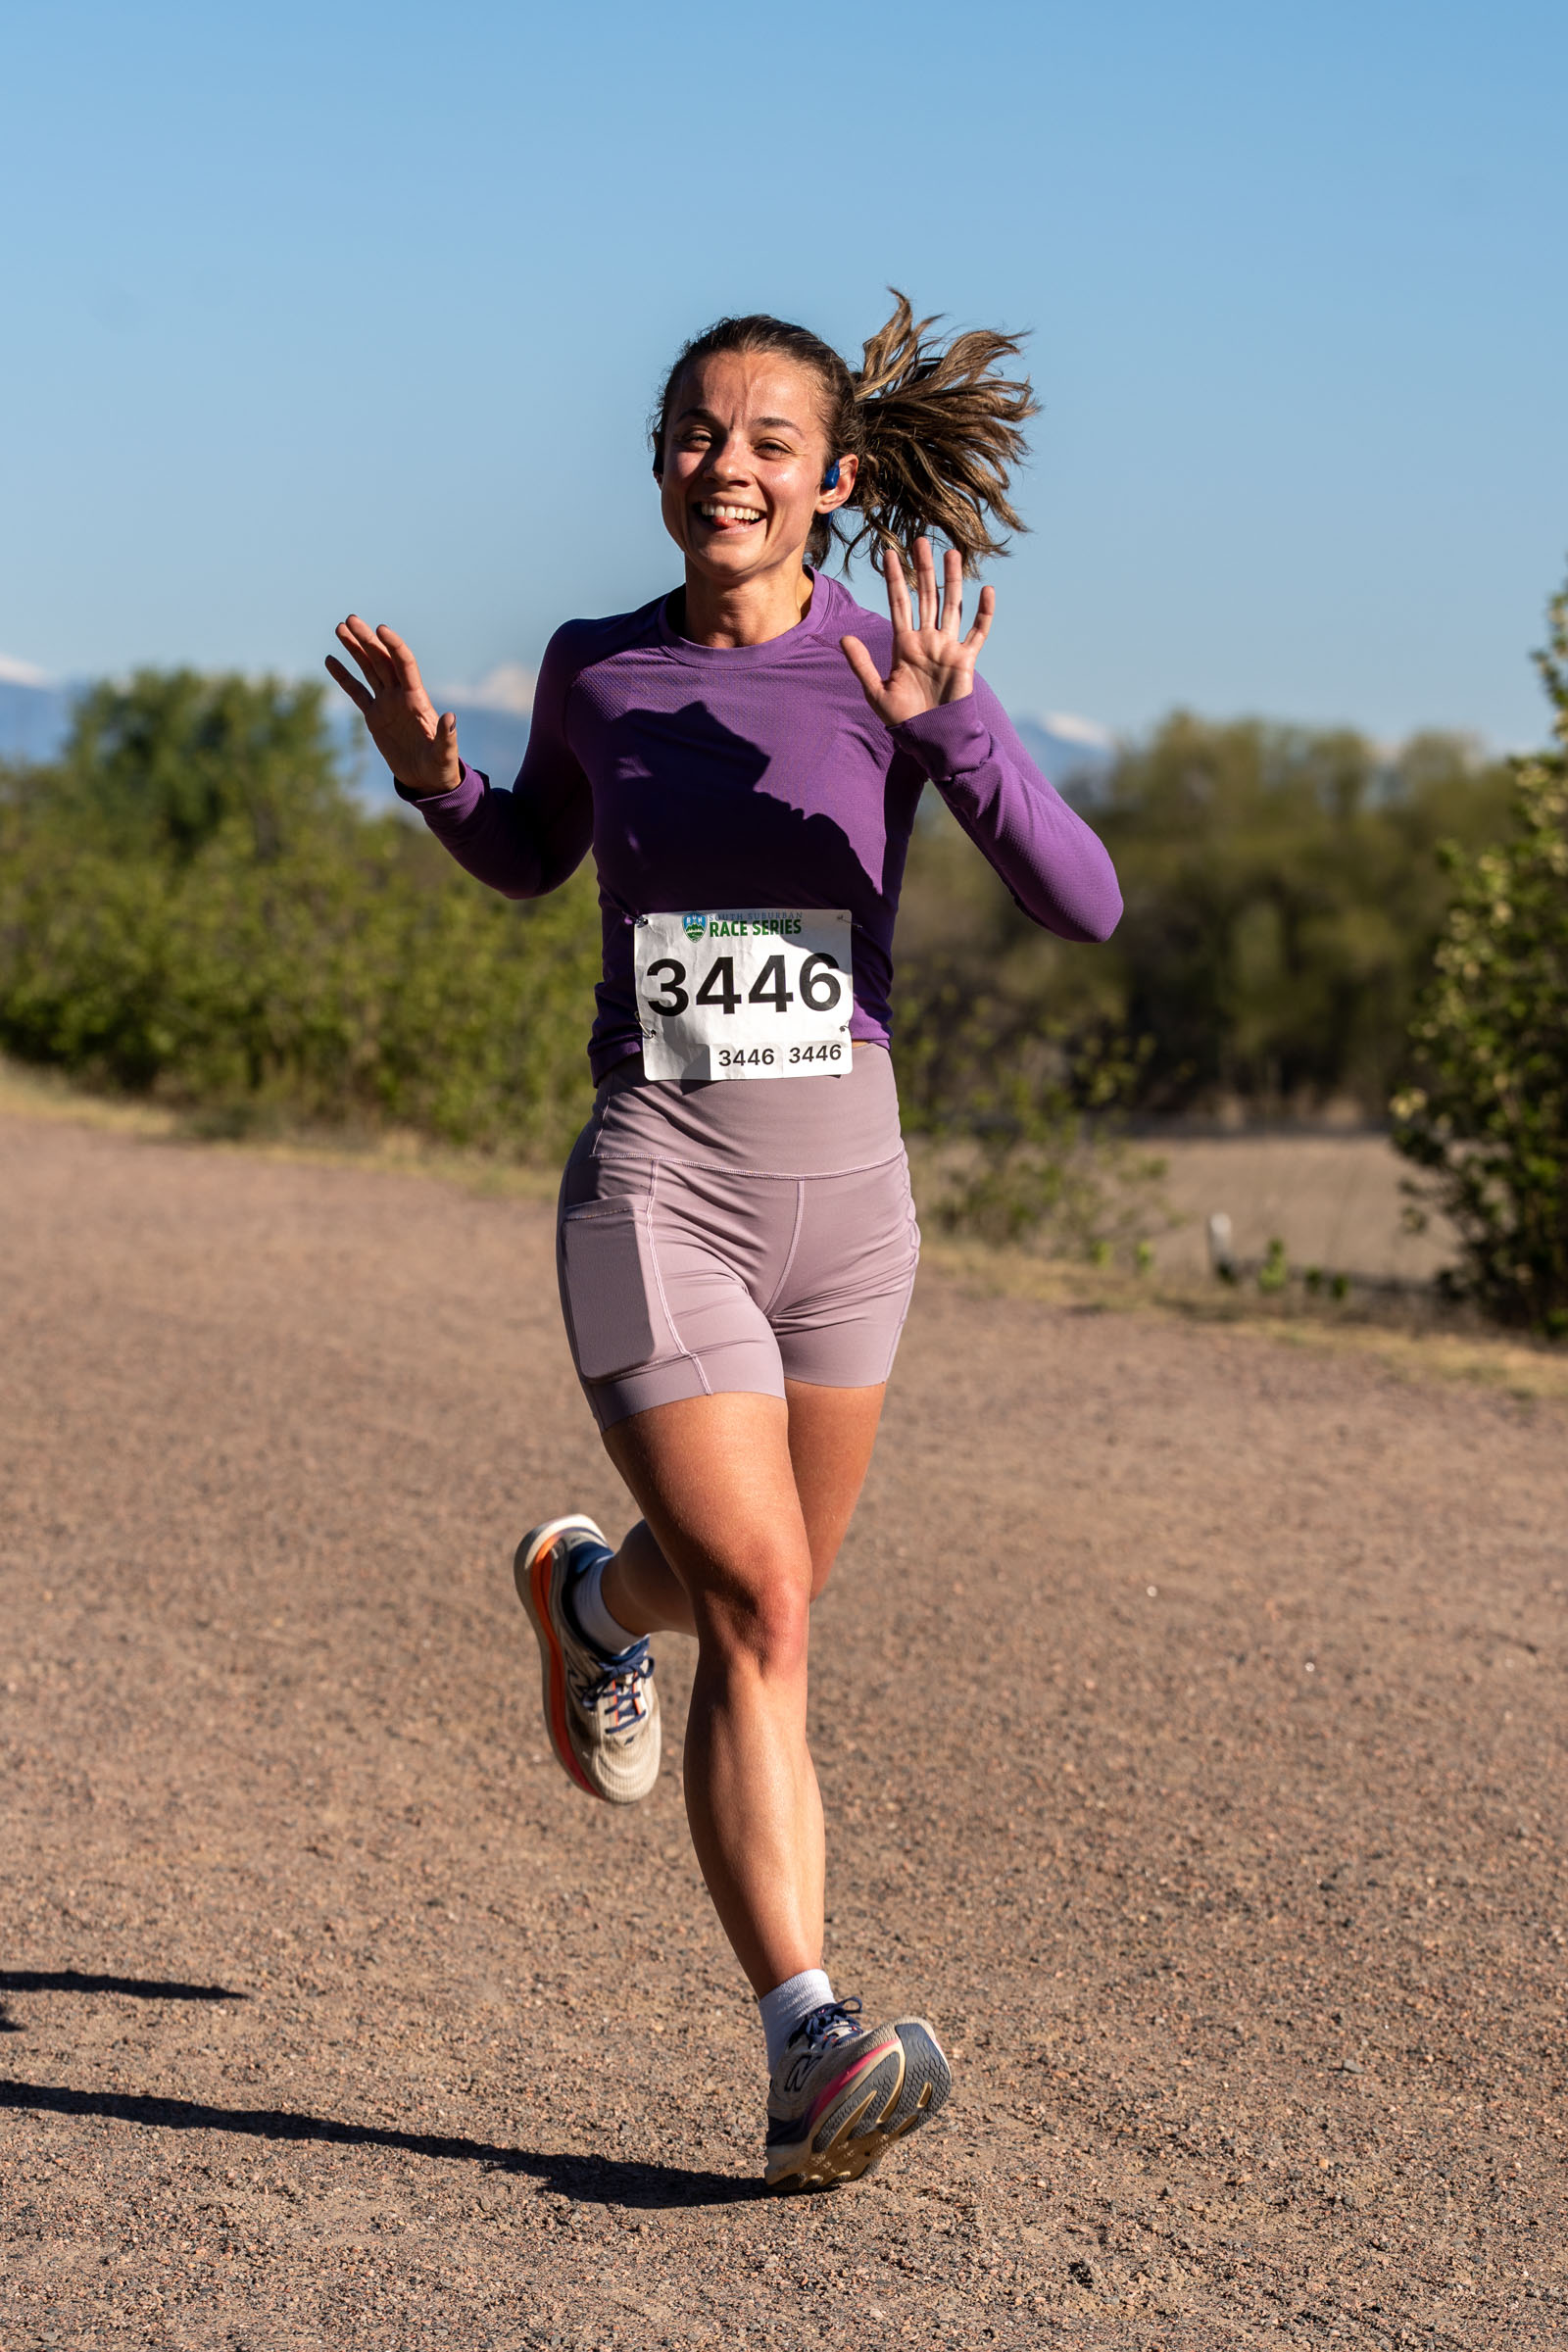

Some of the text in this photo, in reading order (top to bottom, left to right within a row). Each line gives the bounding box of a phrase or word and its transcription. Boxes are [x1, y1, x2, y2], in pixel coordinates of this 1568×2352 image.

[686, 913, 703, 923] RUN
[748, 911, 803, 920] SUBURBAN
[710, 919, 802, 937] RACE SERIES
[647, 953, 841, 1017] 3446
[718, 1045, 842, 1066] 3446 3446
